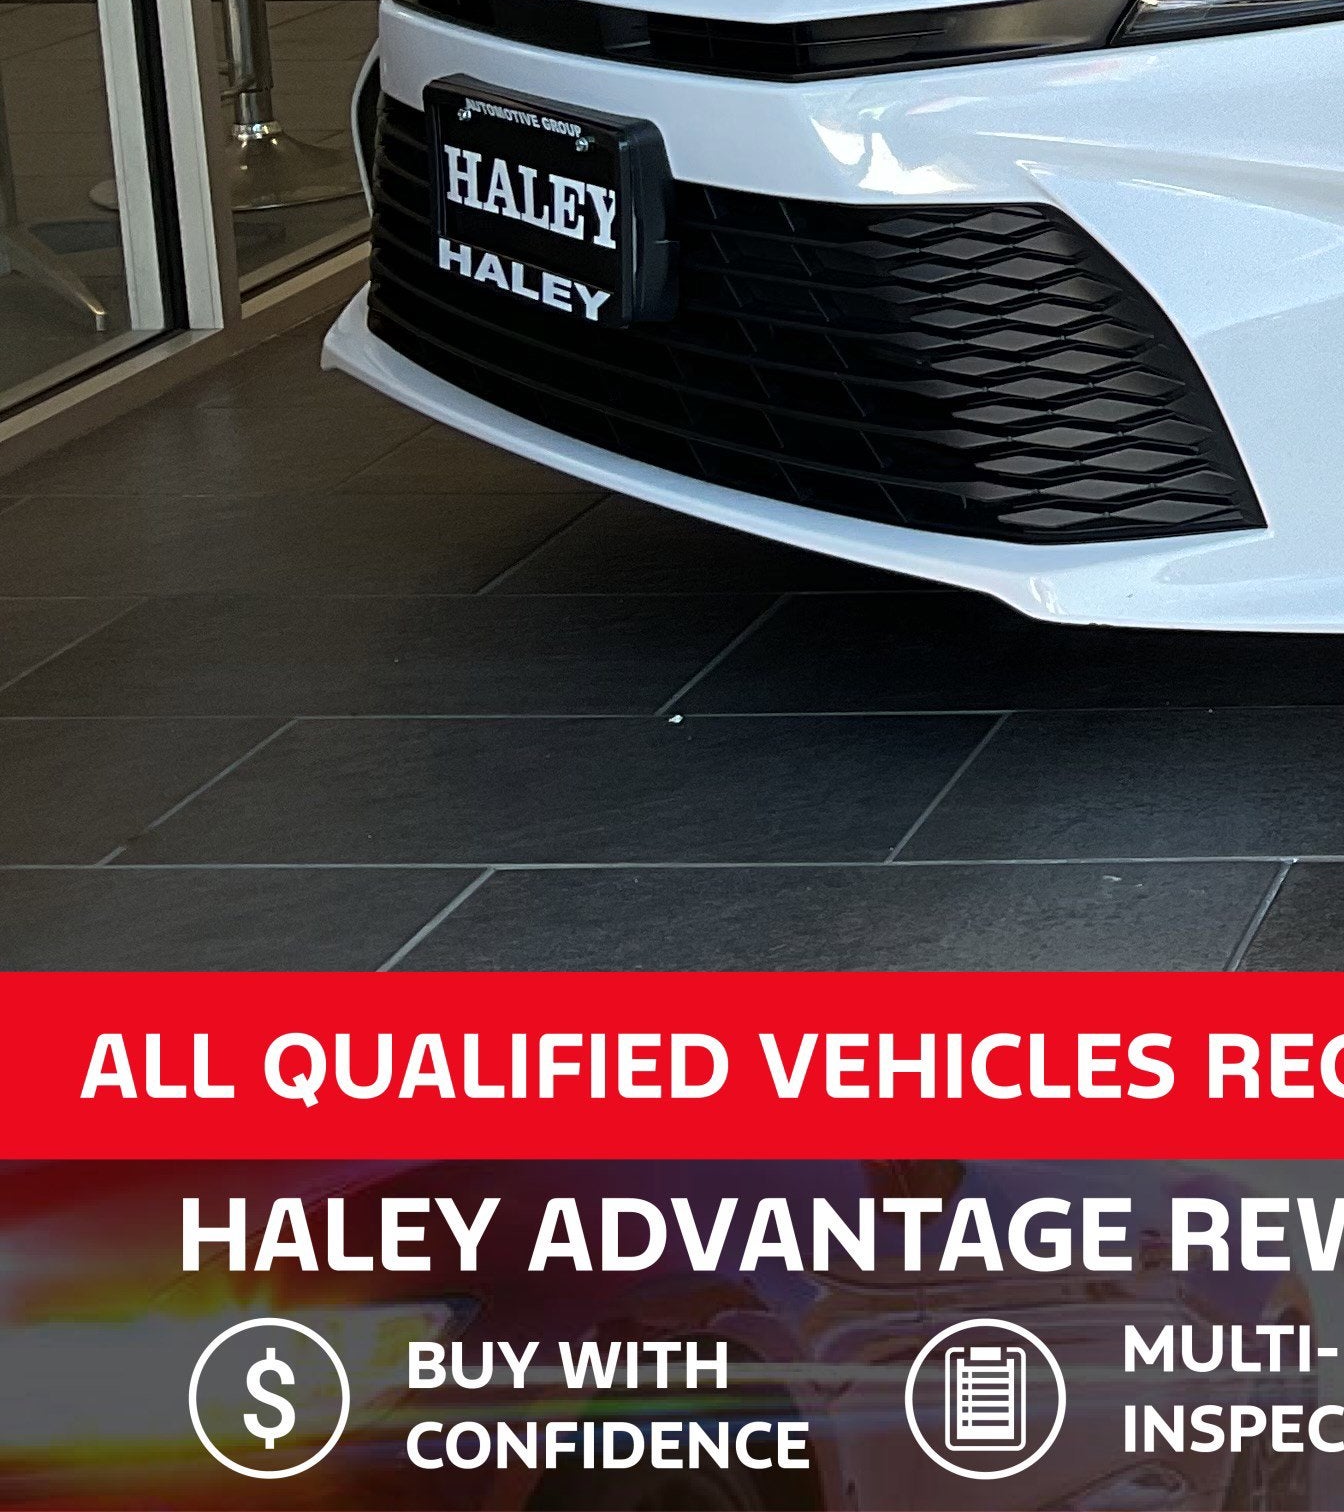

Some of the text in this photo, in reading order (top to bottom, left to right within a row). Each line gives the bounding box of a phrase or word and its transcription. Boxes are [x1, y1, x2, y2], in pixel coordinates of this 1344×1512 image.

[465, 97, 582, 138] AUTOMOTIVE GROUP
[444, 144, 617, 250] HALEY
[438, 237, 611, 322] HALEY
